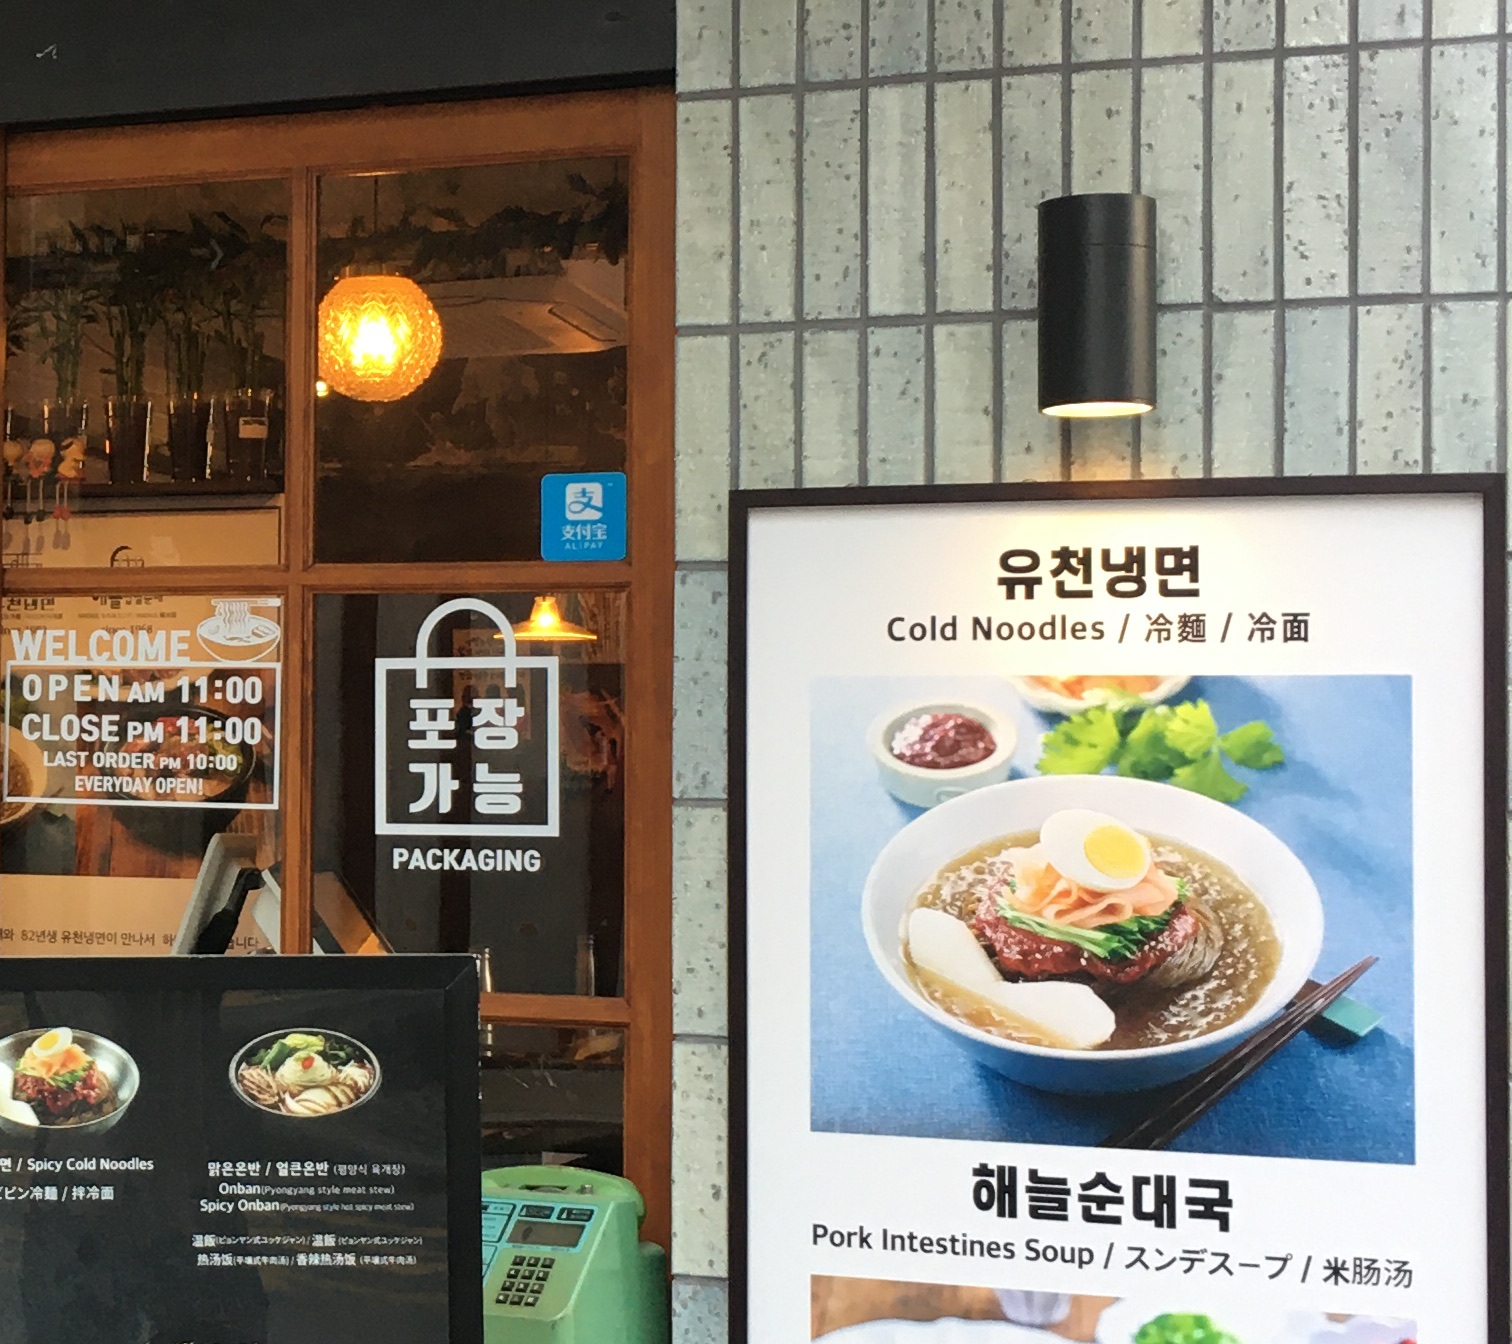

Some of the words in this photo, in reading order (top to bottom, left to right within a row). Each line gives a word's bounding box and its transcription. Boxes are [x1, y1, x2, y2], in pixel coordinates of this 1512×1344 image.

[560, 522, 608, 541] 支付宝
[997, 544, 1201, 600] 유천냉면
[887, 614, 958, 643] Cold
[972, 614, 1105, 643] Noodles
[1248, 611, 1312, 645] 冷面
[11, 629, 191, 663] WELCOME
[23, 673, 120, 703] OPEN
[127, 680, 165, 704] AM
[177, 675, 262, 705] 11:00
[21, 713, 120, 743] CLOSE
[126, 720, 164, 744] PM
[176, 716, 262, 746] 11:00
[407, 697, 526, 750] 포장
[43, 751, 90, 768] LAST
[92, 751, 155, 770] ORDER
[159, 757, 181, 771] PM
[186, 754, 238, 772] 10:00
[74, 775, 154, 795] EVERYDAY
[155, 776, 204, 796] OPEN!
[408, 762, 524, 815] 가능
[392, 847, 542, 873] PACKAGING
[60, 929, 118, 946] 유천냉면이
[121, 931, 156, 947] 만나서
[27, 1157, 63, 1173] Spicy
[66, 1158, 96, 1171] Cold
[99, 1157, 154, 1171] Noodles
[208, 1161, 261, 1177] 맑은온반
[275, 1161, 329, 1177] 얼큰온반
[199, 1199, 234, 1213] Spicy
[972, 1163, 1234, 1233] 해늘순대국
[812, 1223, 873, 1251] Pork
[881, 1229, 1016, 1260] Intestines
[1025, 1237, 1096, 1269] Soup
[1126, 1244, 1293, 1281] スンデスープ
[1322, 1257, 1414, 1289] 米肠汤
